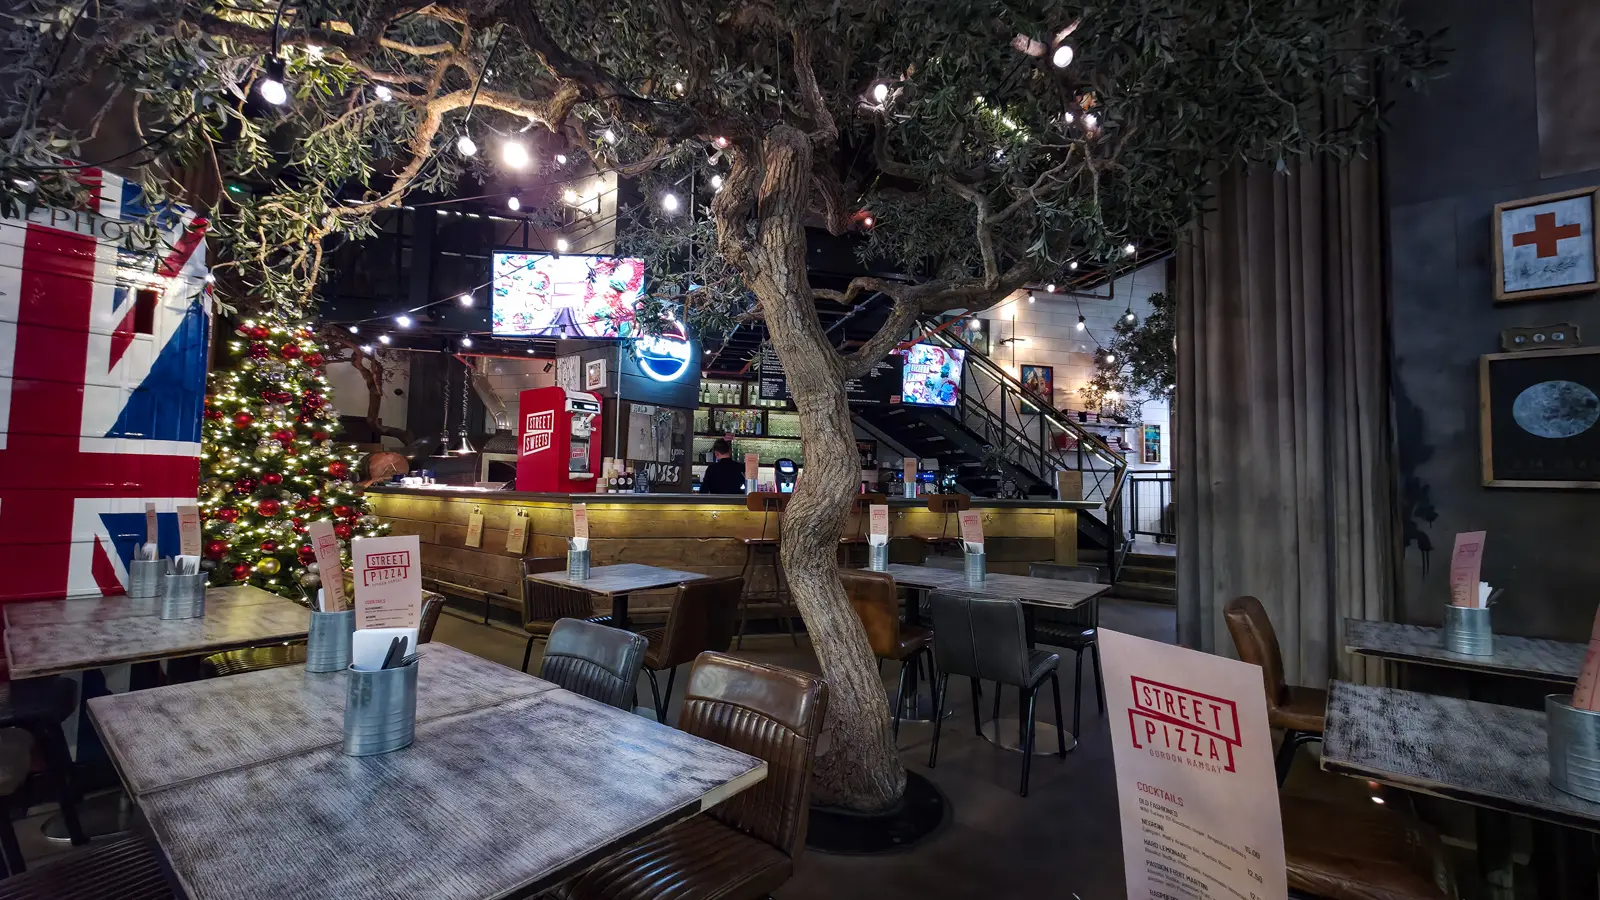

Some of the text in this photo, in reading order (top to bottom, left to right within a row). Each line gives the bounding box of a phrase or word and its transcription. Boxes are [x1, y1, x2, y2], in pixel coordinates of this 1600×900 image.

[529, 415, 551, 429] STREET
[525, 433, 549, 451] SWEETS
[371, 554, 404, 566] STREET
[370, 567, 402, 582] PIZZA
[1143, 685, 1222, 731] STREET
[1144, 719, 1220, 761] PIZZA
[1149, 748, 1222, 774] GORDON RAMSAY
[1136, 781, 1184, 807] COCKTAILS
[1138, 797, 1149, 806] OLD
[1247, 868, 1263, 884] 12.50
